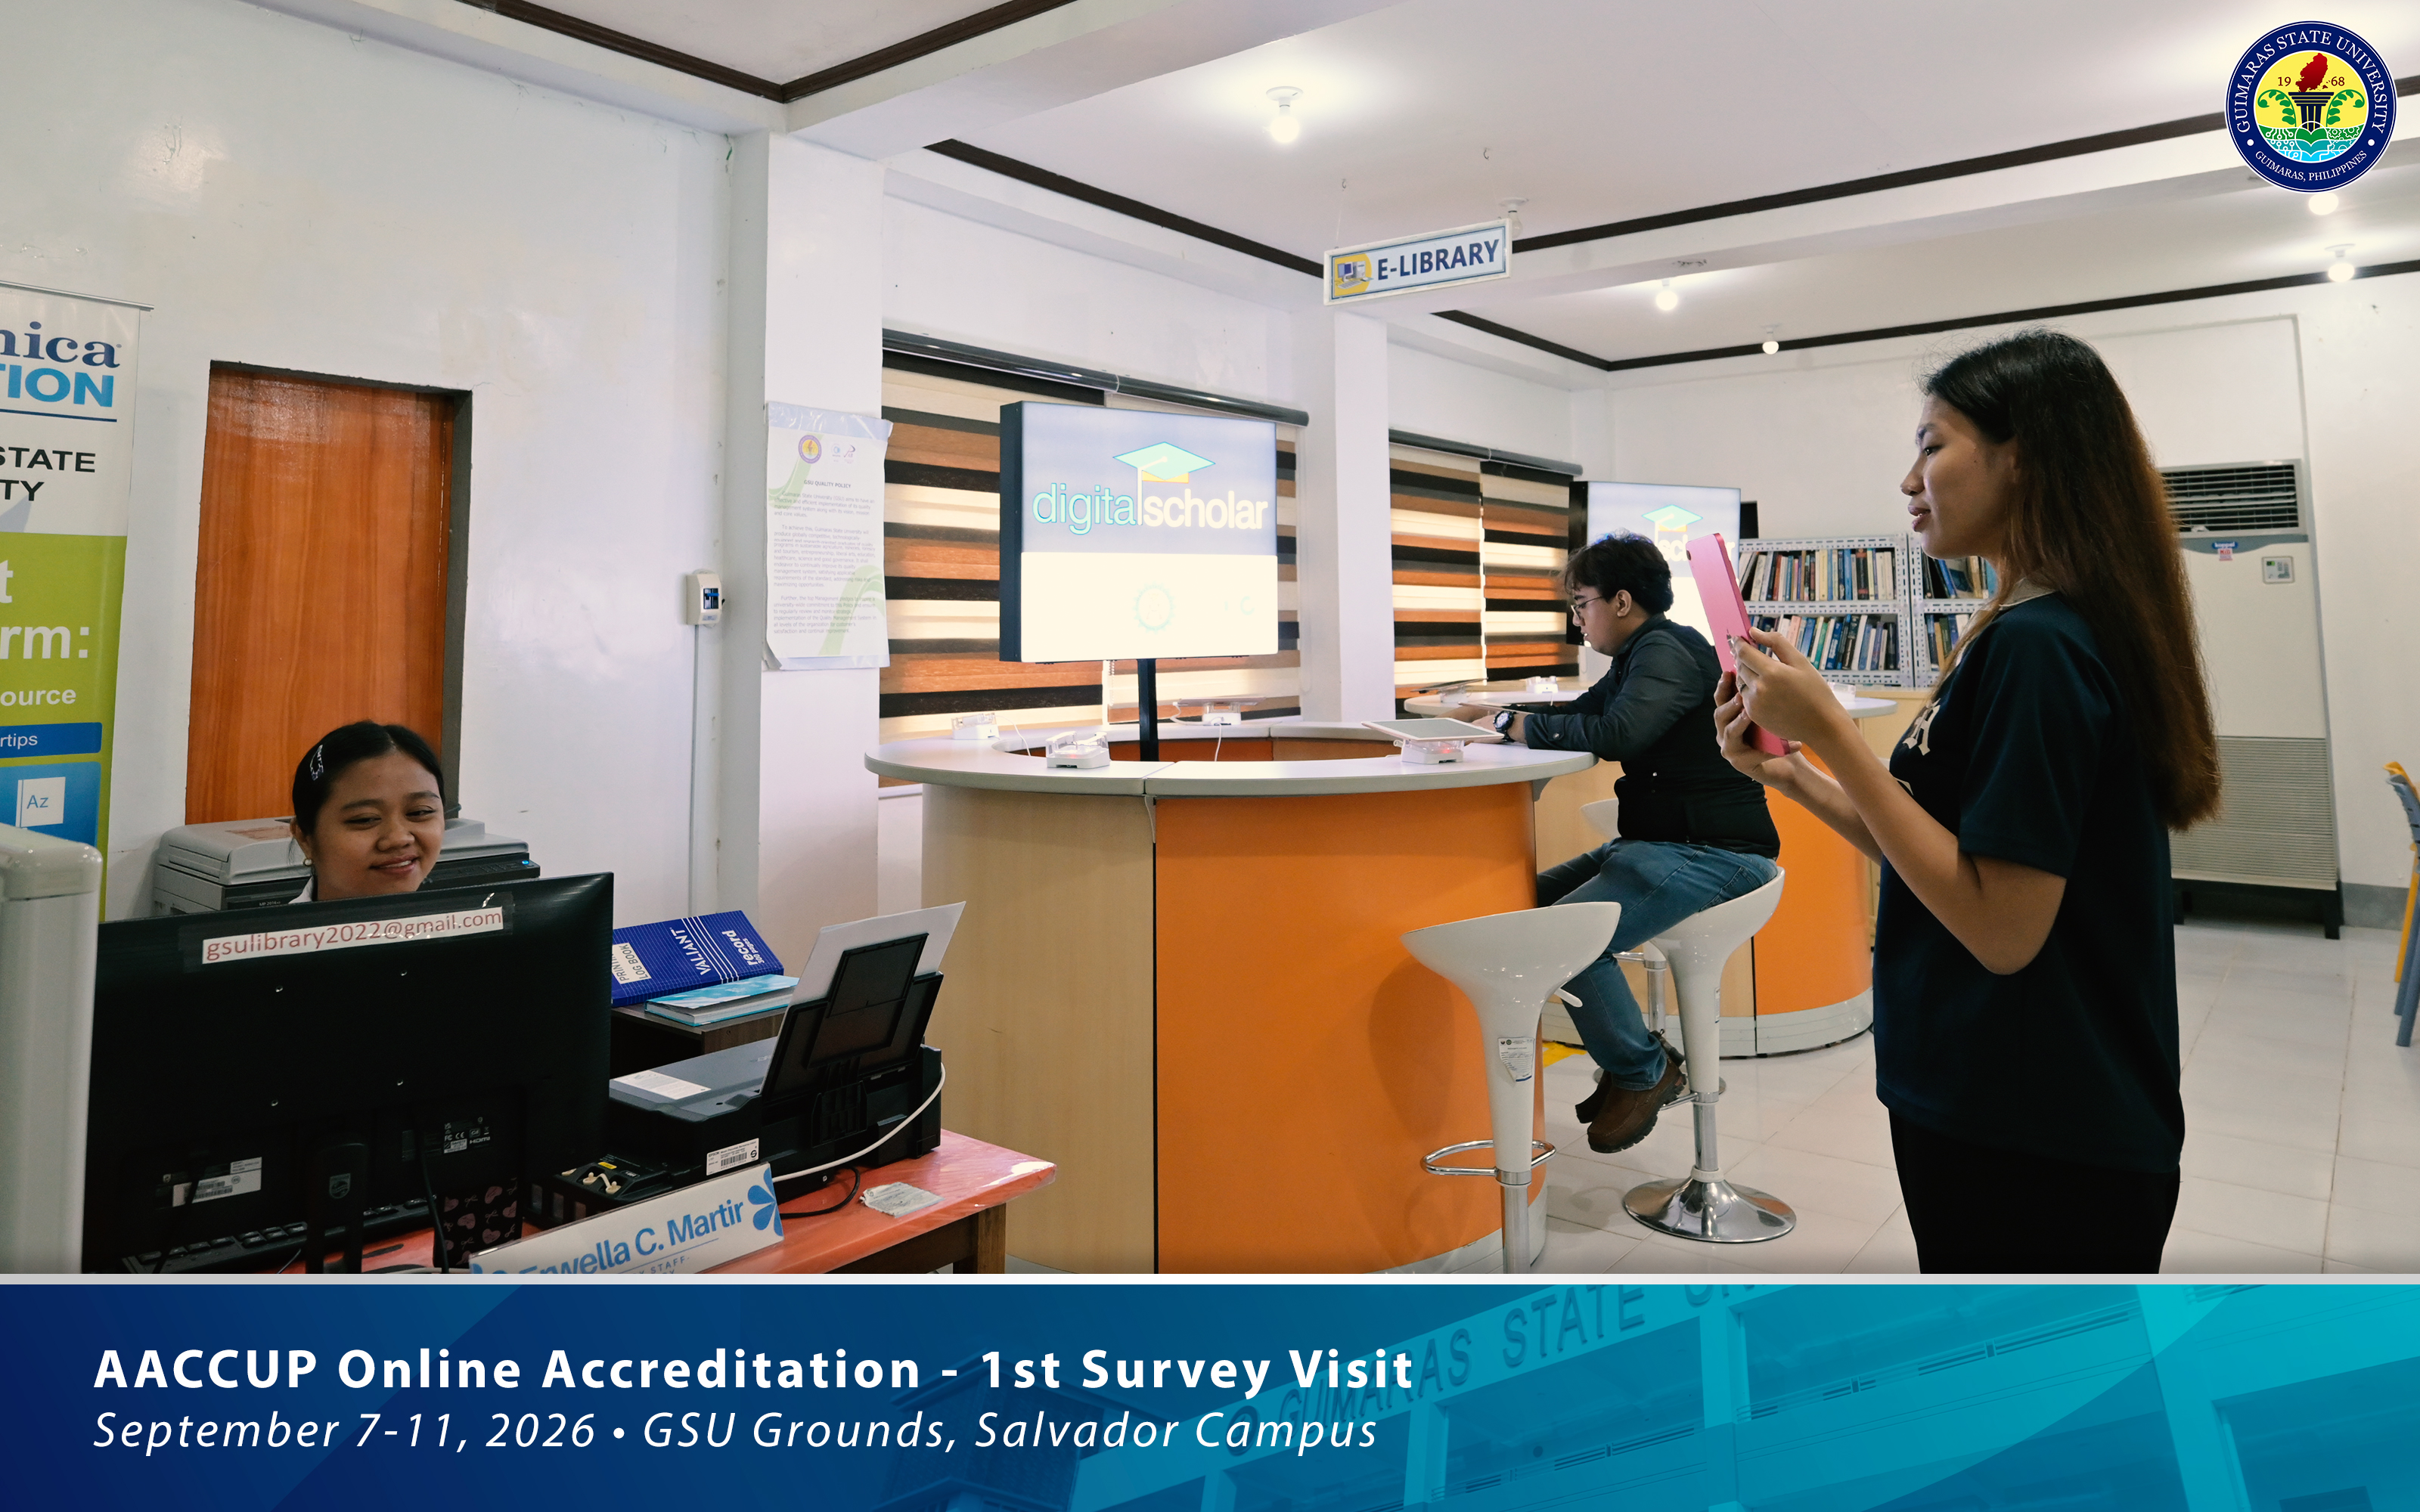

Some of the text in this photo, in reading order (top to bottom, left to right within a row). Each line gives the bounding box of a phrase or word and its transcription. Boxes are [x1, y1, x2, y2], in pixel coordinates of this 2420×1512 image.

[1378, 239, 1499, 280] E-LIBRARY
[0, 689, 76, 706] ource
[0, 733, 38, 749] rtips
[26, 795, 49, 809] Az
[207, 911, 501, 961] gsulibrary2022@gmail.com
[721, 930, 758, 965] record
[743, 938, 765, 964] 300 pages
[619, 944, 649, 979] LOG BOOK
[635, 1228, 665, 1256] C.
[668, 1200, 744, 1246] Martir
